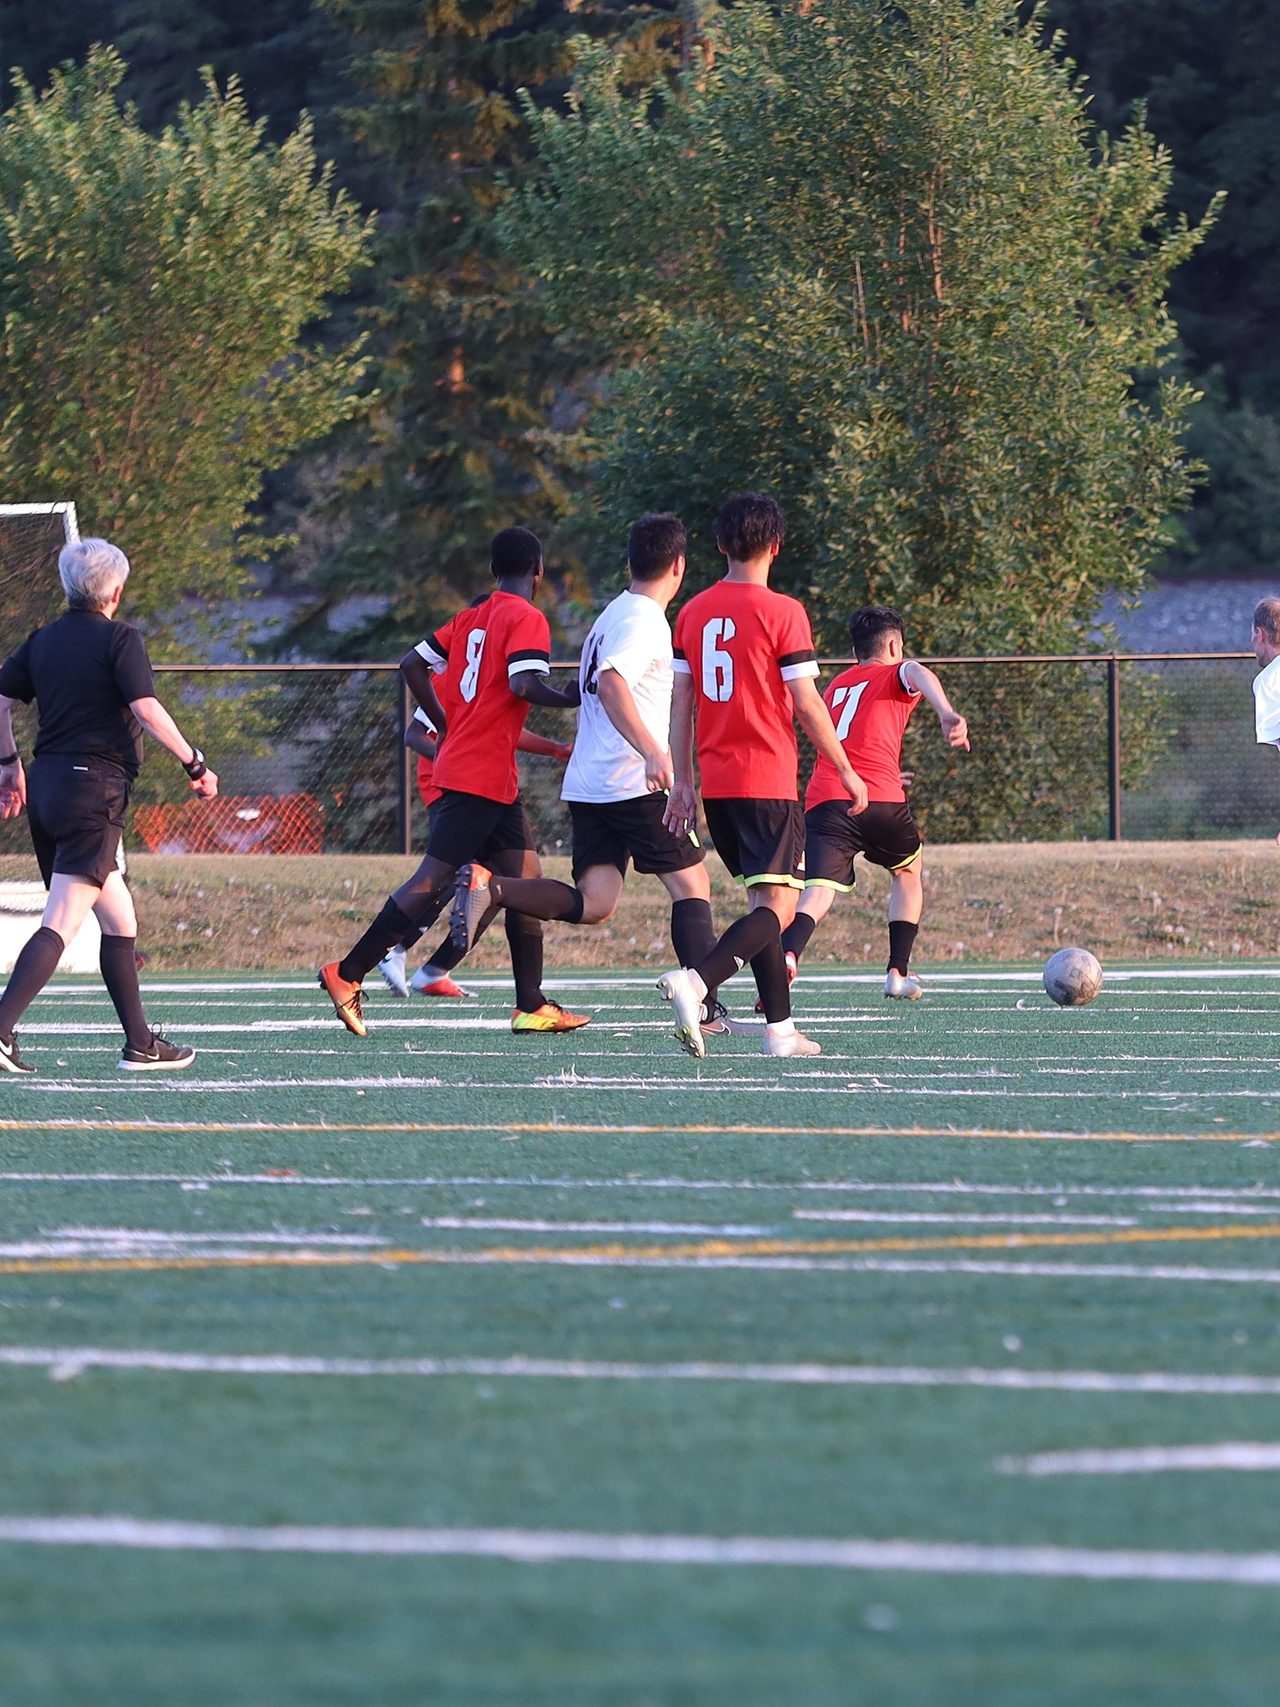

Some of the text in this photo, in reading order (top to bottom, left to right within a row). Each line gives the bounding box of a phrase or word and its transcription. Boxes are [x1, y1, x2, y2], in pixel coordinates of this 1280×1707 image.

[459, 628, 487, 703] 8
[702, 617, 736, 702] 6
[831, 680, 869, 742] 7
